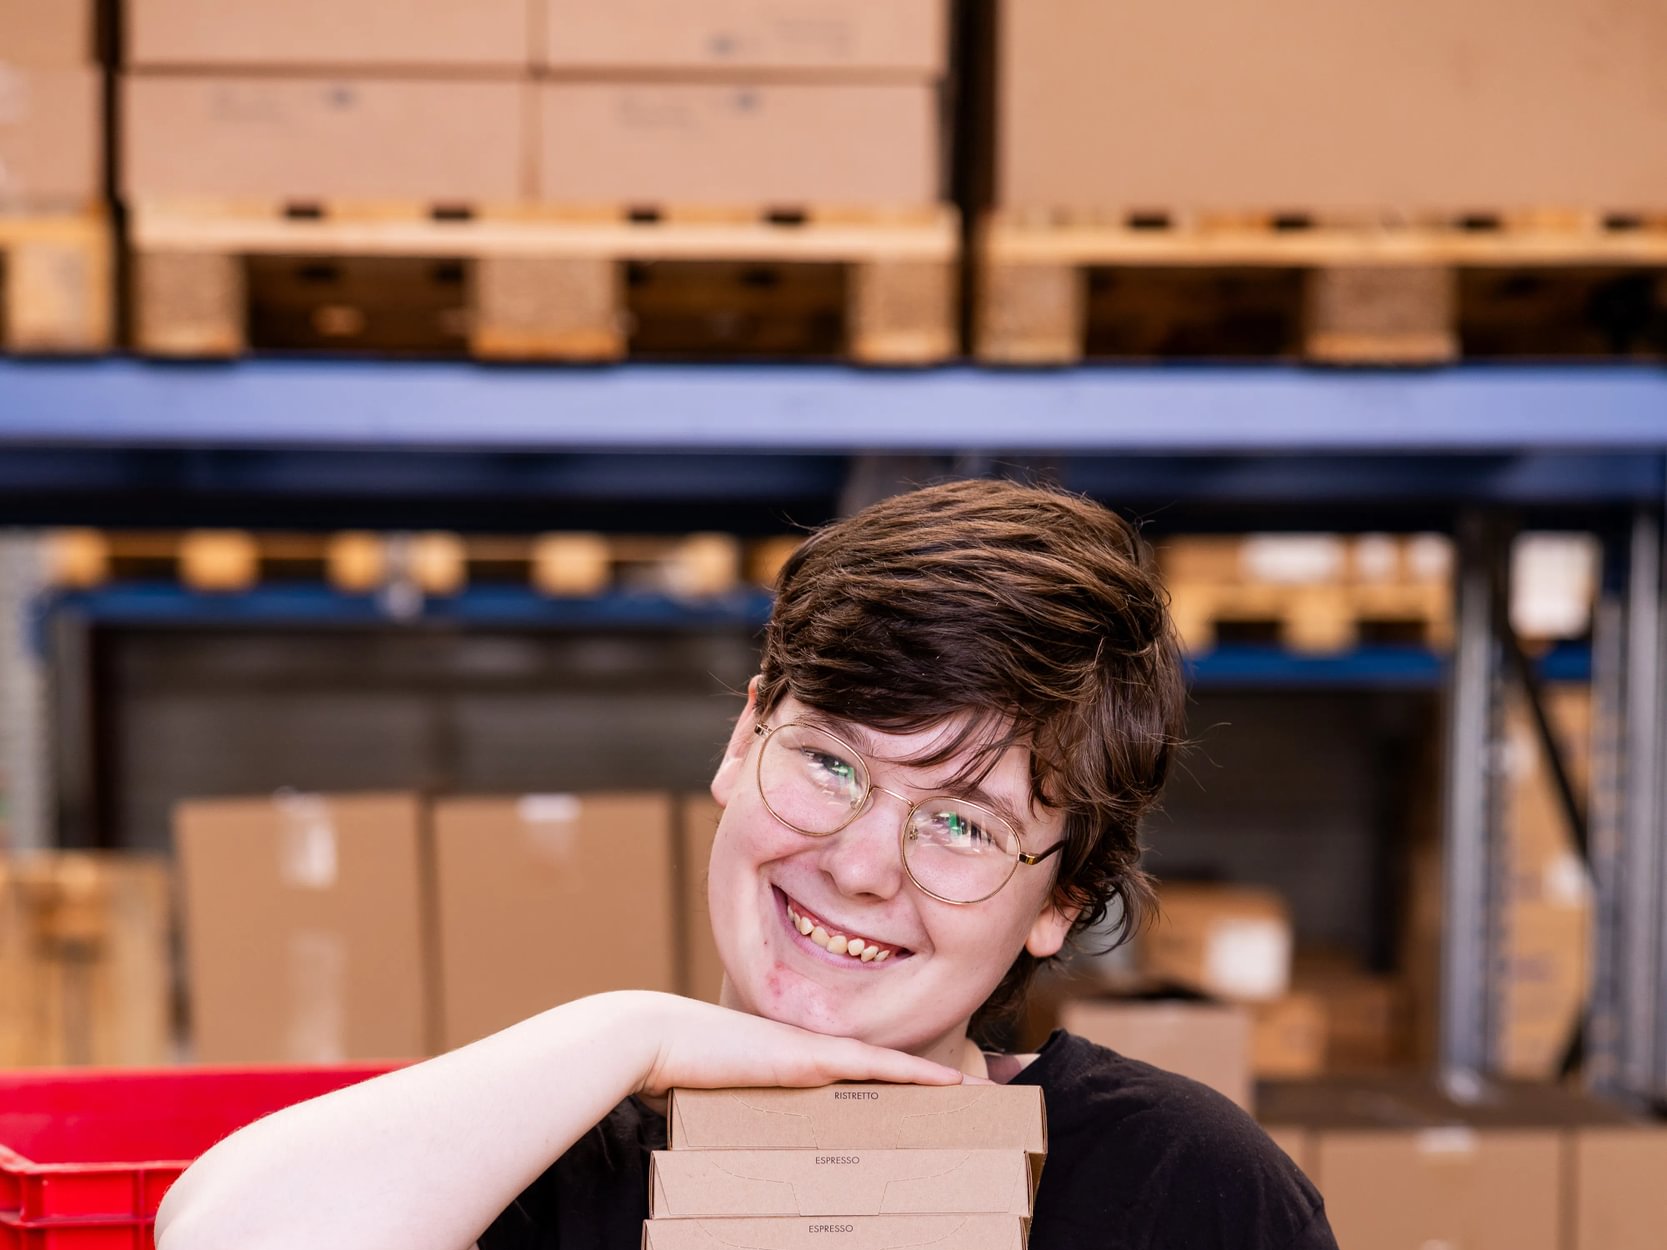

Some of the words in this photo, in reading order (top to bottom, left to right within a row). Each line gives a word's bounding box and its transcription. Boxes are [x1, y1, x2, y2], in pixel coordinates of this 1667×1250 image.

[834, 1091, 879, 1100] RISTRETTO
[815, 1156, 860, 1165] ESPRESSO
[808, 1224, 854, 1233] ESPRESSO
